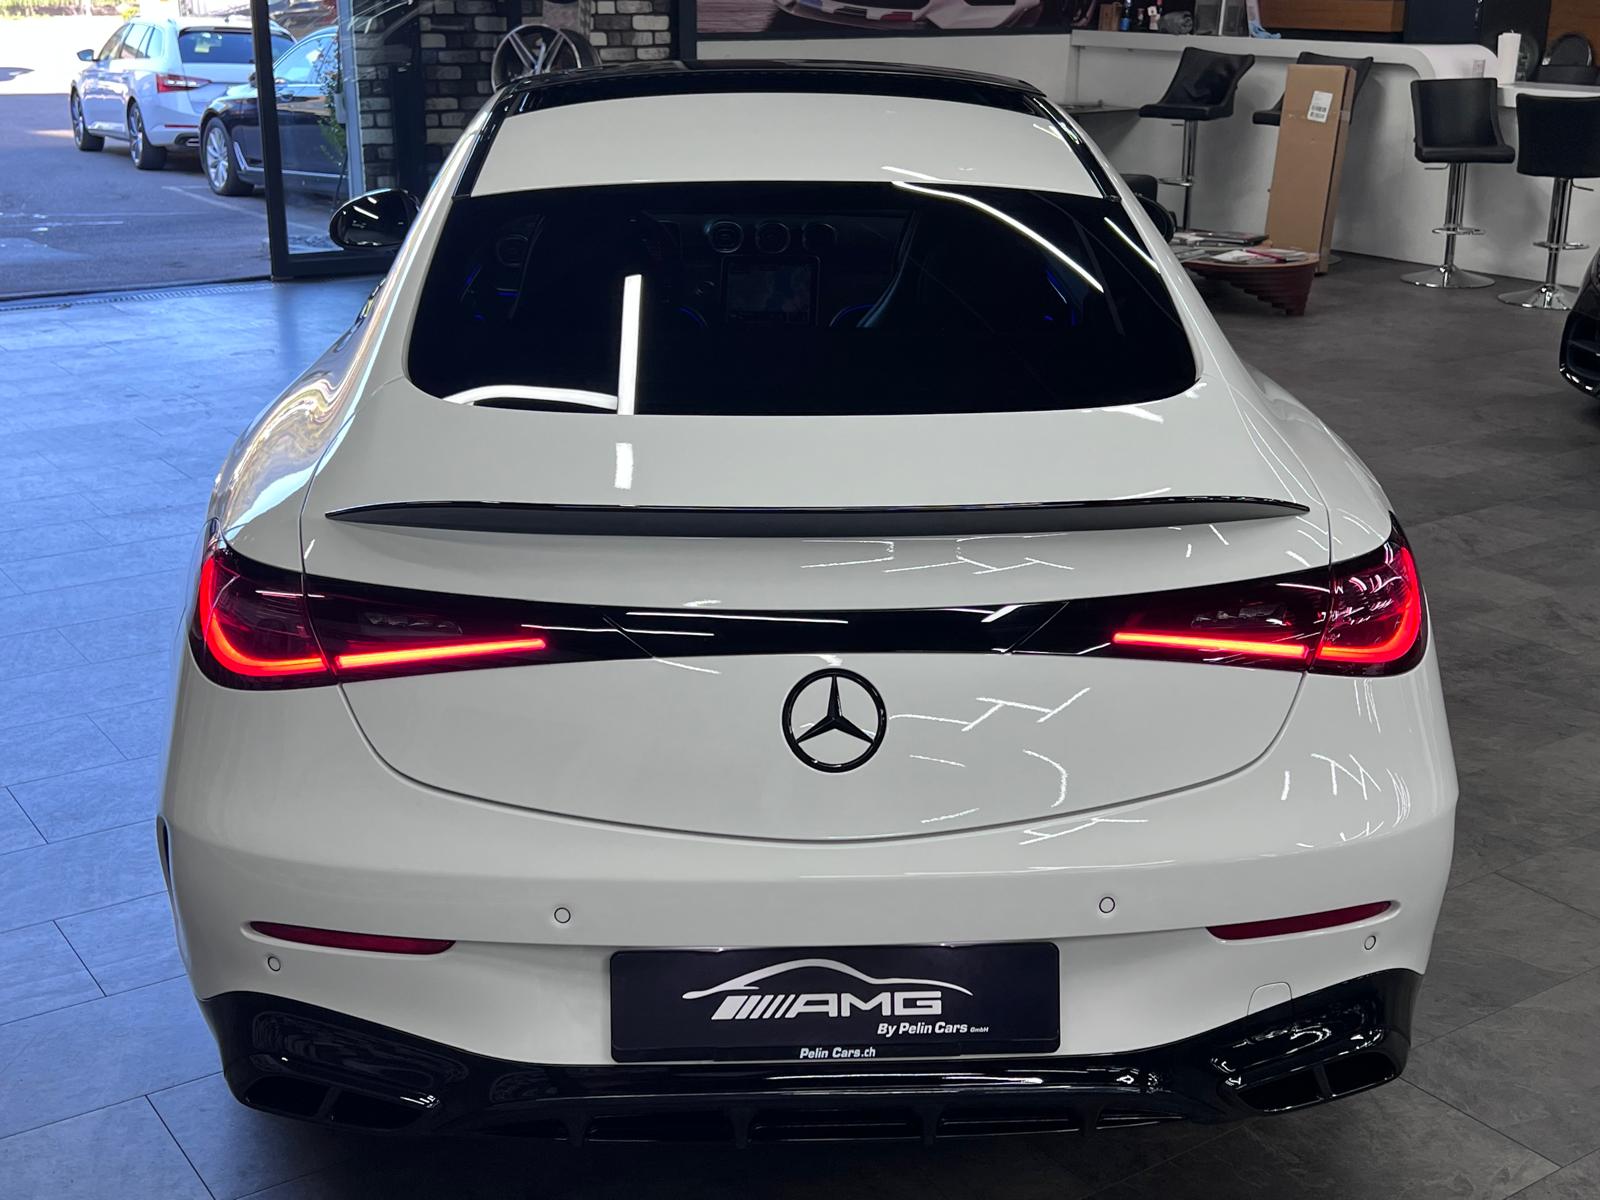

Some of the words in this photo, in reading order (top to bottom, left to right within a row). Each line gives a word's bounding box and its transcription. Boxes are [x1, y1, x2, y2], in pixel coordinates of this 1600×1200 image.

[784, 991, 942, 1019] AMG
[877, 1023, 897, 1038] By
[898, 1021, 932, 1035] Pelin
[934, 1021, 968, 1034] Cars
[800, 1047, 829, 1059] Pelin
[832, 1046, 876, 1058] Cars.ch
